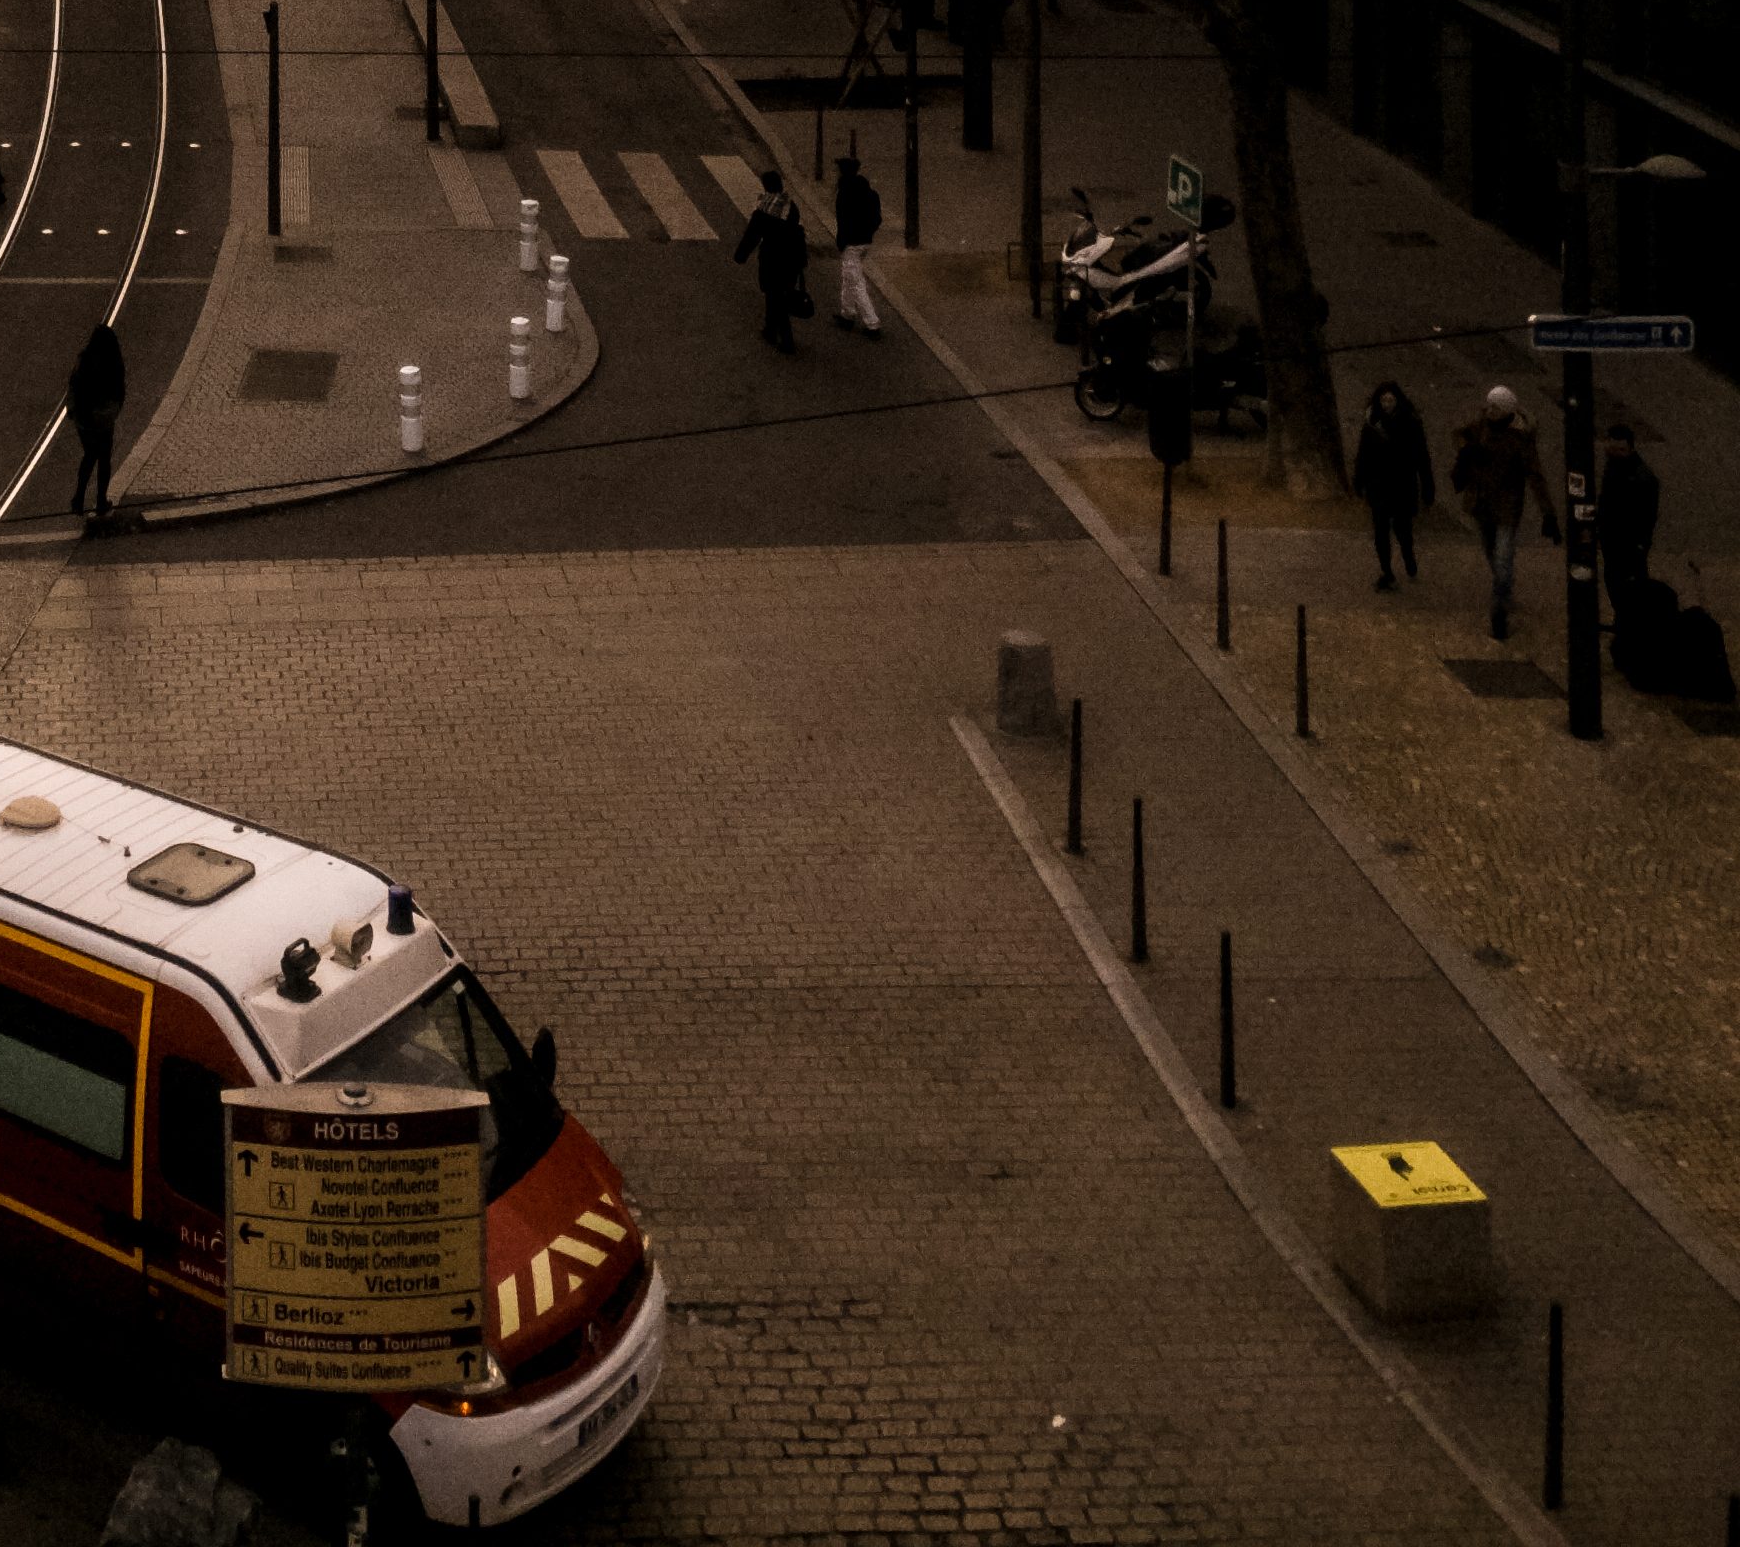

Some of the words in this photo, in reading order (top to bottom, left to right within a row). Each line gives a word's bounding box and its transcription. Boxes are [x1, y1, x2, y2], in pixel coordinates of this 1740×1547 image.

[1177, 171, 1192, 205] P
[314, 1116, 400, 1141] HÔTELS
[271, 1151, 299, 1171] Best
[304, 1155, 354, 1173] Western
[358, 1155, 440, 1176] Charlemagne
[321, 1178, 368, 1196] Novotel
[371, 1178, 439, 1196] Confluence
[354, 1201, 383, 1224] Lyon
[387, 1199, 440, 1218] Perrache
[306, 1227, 328, 1246] Ibis
[332, 1229, 368, 1250] Styles
[372, 1228, 440, 1247] Confluence
[299, 1250, 321, 1268] Ibis
[325, 1252, 369, 1274] Budget
[373, 1252, 441, 1271] Confluence
[365, 1274, 440, 1294] Victoria
[274, 1303, 344, 1326] Berlioz
[264, 1330, 354, 1352] Résidences
[360, 1335, 377, 1352] de
[384, 1334, 452, 1352] Tourisme
[274, 1357, 311, 1379] Quality
[315, 1358, 348, 1378] Suites
[351, 1362, 411, 1380] Confluence
